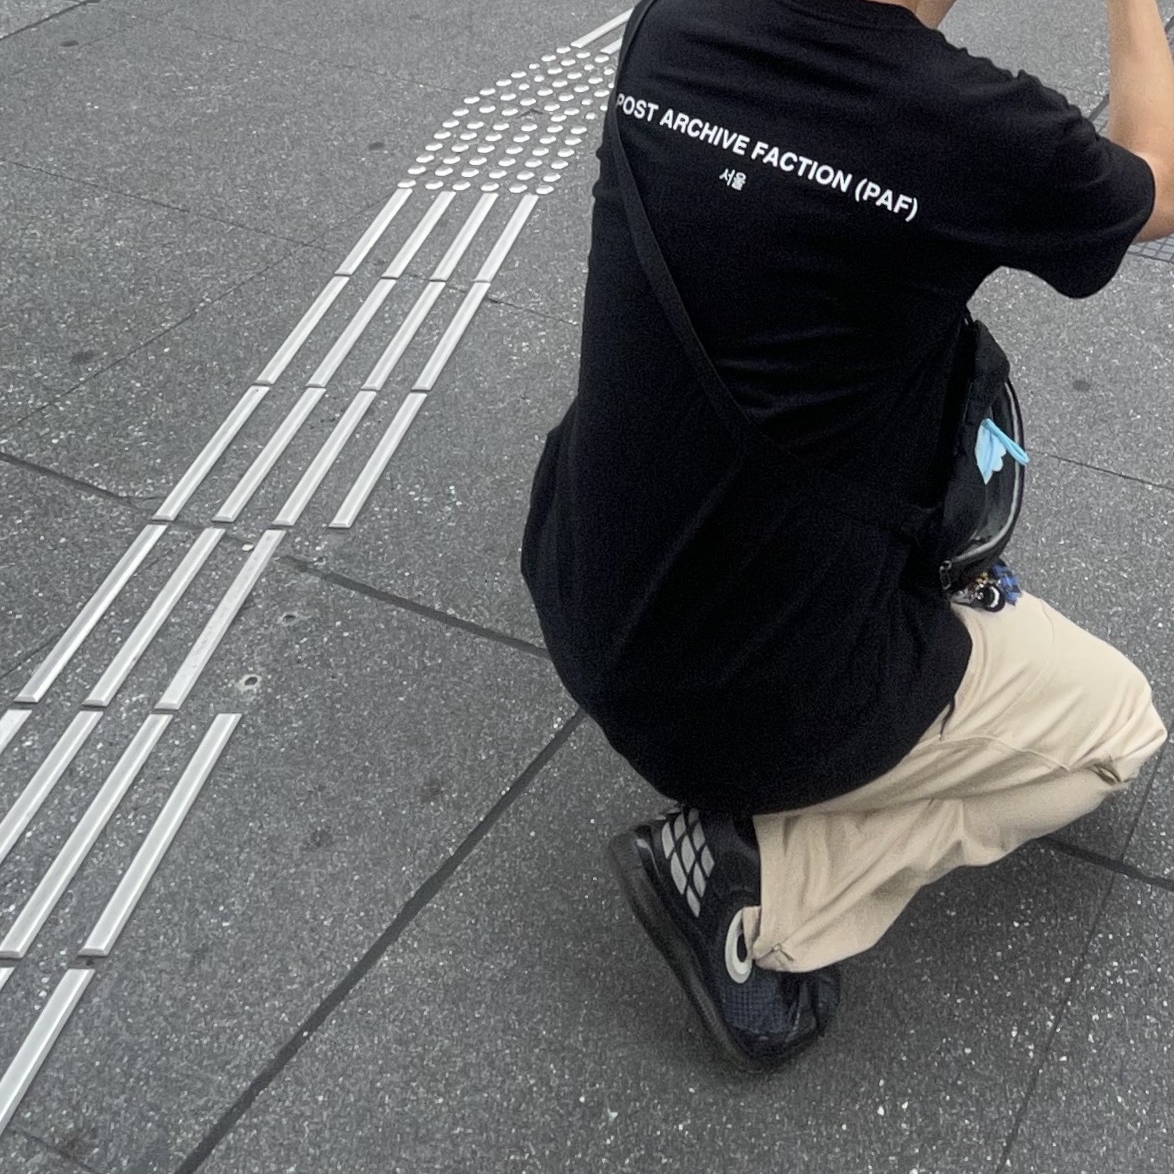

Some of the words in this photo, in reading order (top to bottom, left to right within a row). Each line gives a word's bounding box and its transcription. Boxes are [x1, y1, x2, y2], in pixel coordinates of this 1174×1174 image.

[616, 93, 659, 122] POST
[660, 109, 750, 155] ARCHIVE
[751, 141, 852, 193] FACTION
[854, 178, 919, 222] (PAF)
[719, 168, 747, 191] 서울
